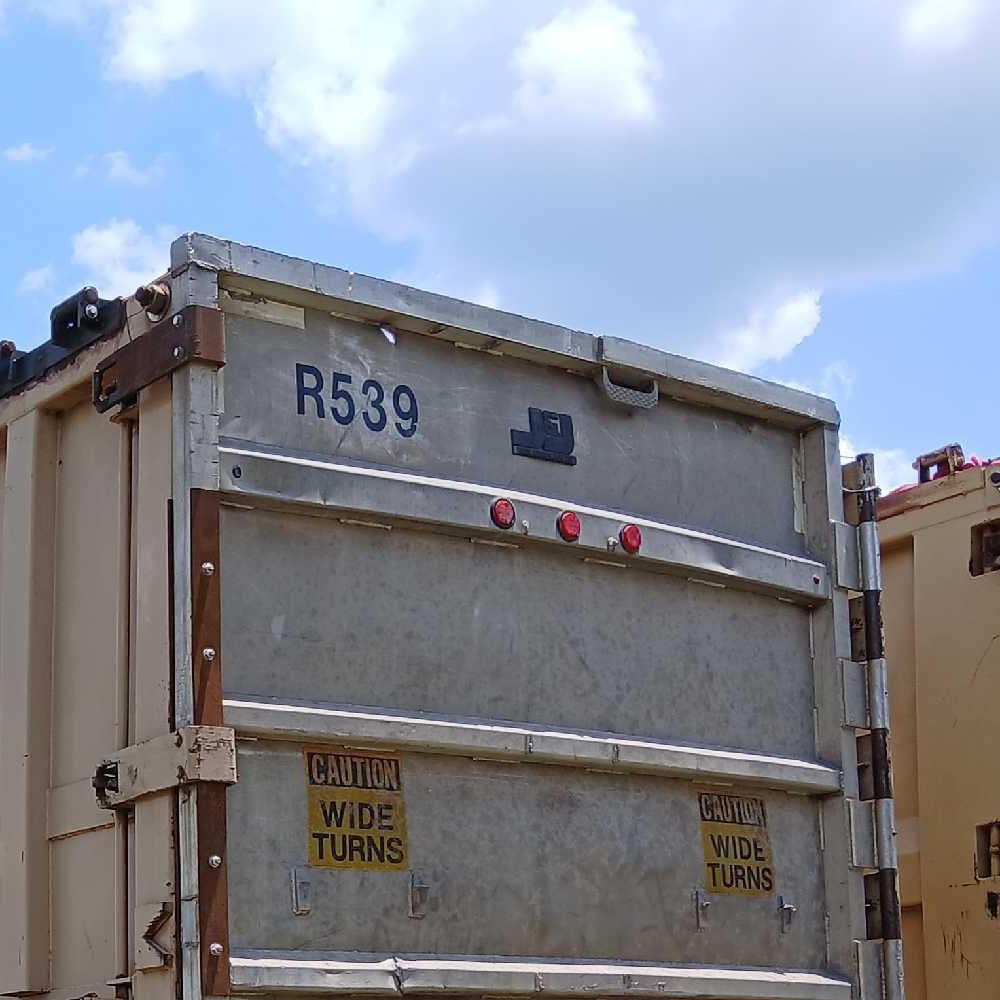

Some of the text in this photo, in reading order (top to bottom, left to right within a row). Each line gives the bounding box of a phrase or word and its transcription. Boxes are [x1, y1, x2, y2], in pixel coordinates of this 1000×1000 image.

[295, 362, 419, 438] R539
[311, 754, 399, 790] CAUTION
[320, 800, 394, 830] WIDE
[701, 794, 765, 827] CAUTION
[312, 833, 404, 864] TURNS
[710, 834, 766, 861] WIDE
[707, 863, 773, 891] TURNS
